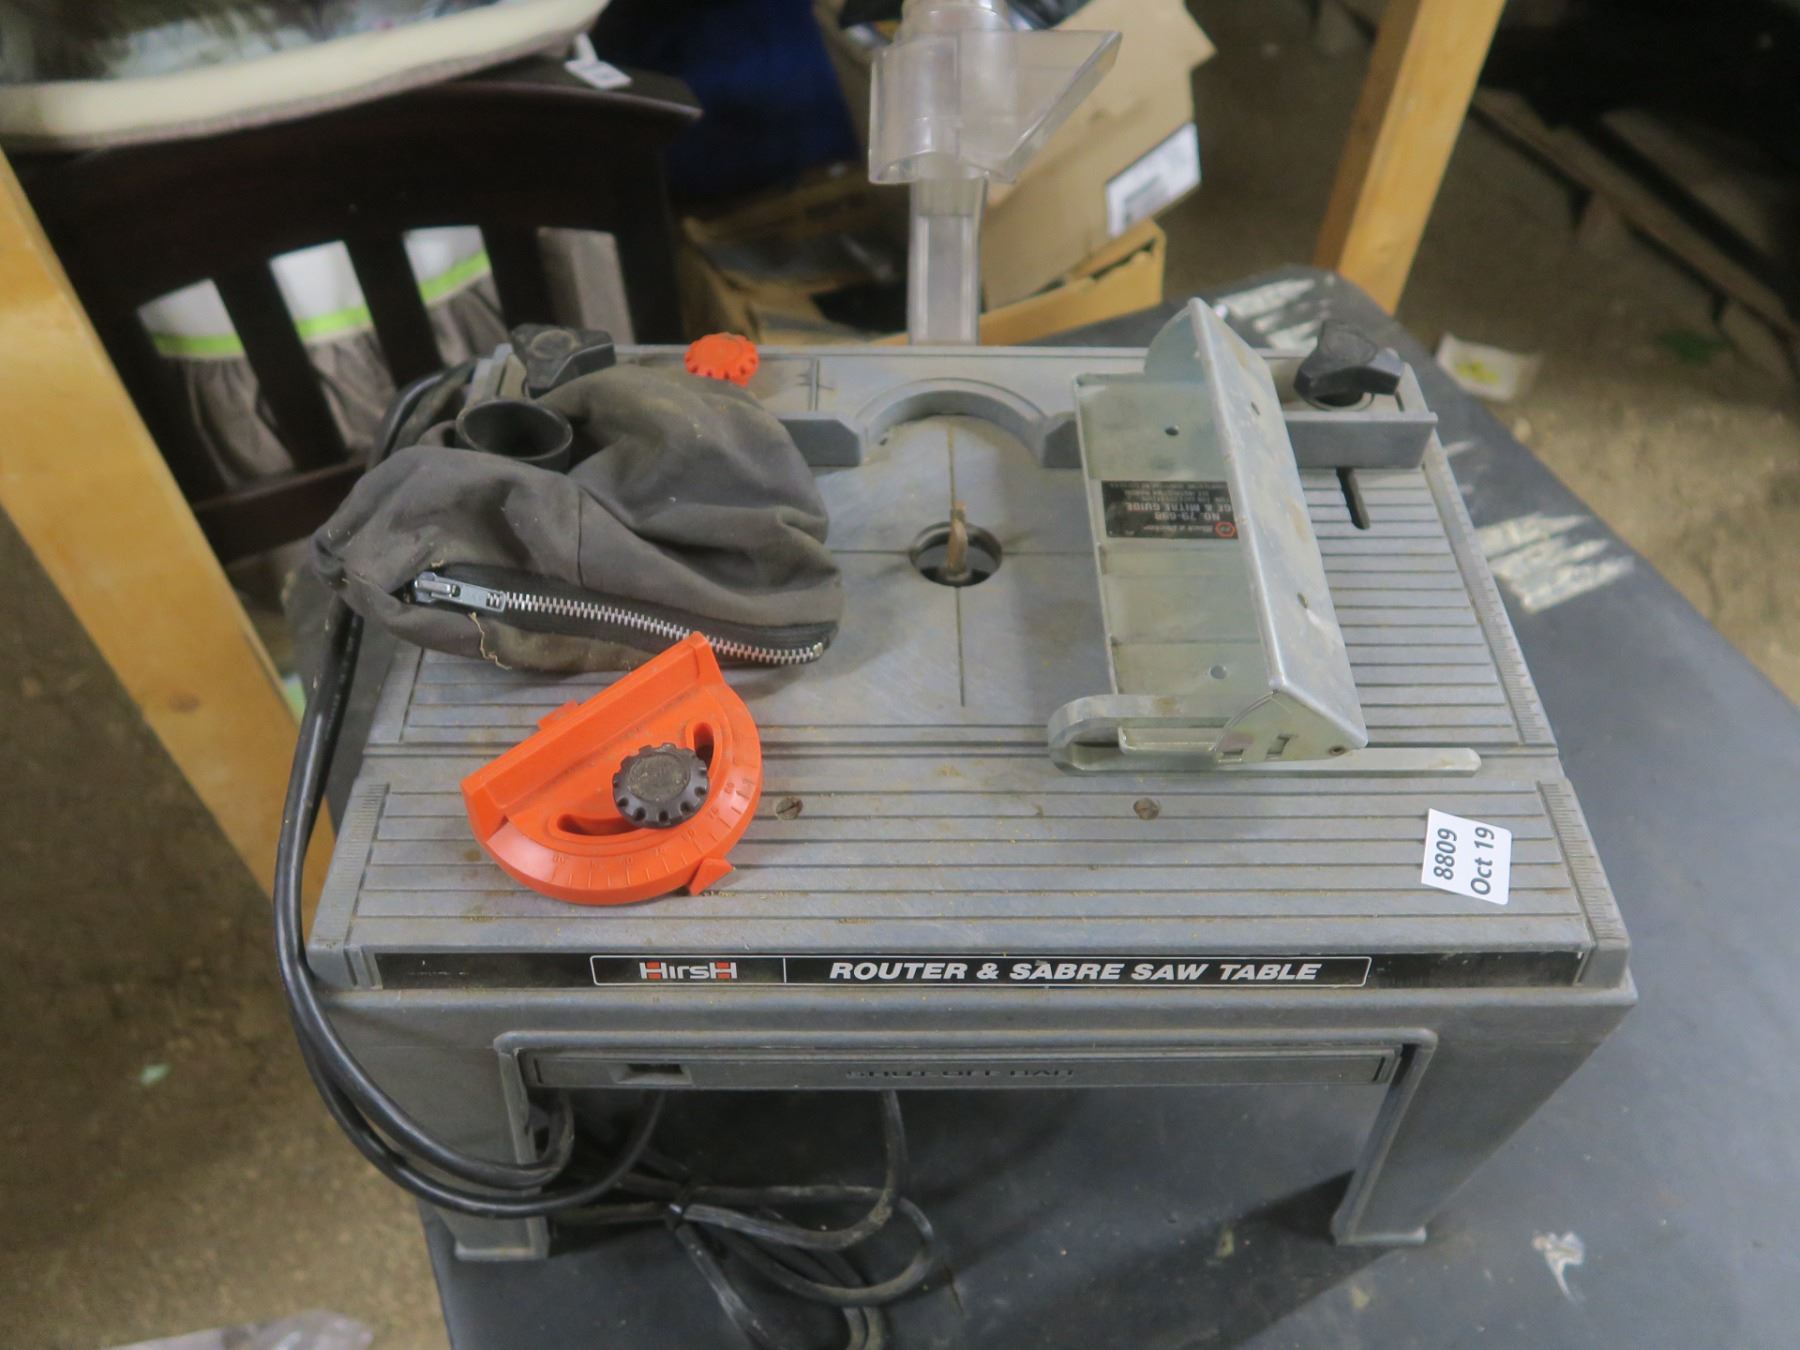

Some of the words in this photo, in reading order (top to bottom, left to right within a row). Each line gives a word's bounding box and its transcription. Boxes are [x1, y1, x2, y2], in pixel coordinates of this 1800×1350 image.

[1474, 827, 1495, 848] 19
[1433, 828, 1457, 880] 8809
[1470, 857, 1493, 895] Oct
[829, 962, 969, 981] ROUTER
[976, 962, 998, 980] &
[1009, 962, 1124, 980] SABRE
[1130, 962, 1208, 980] SAW
[1219, 962, 1323, 981] TABLE
